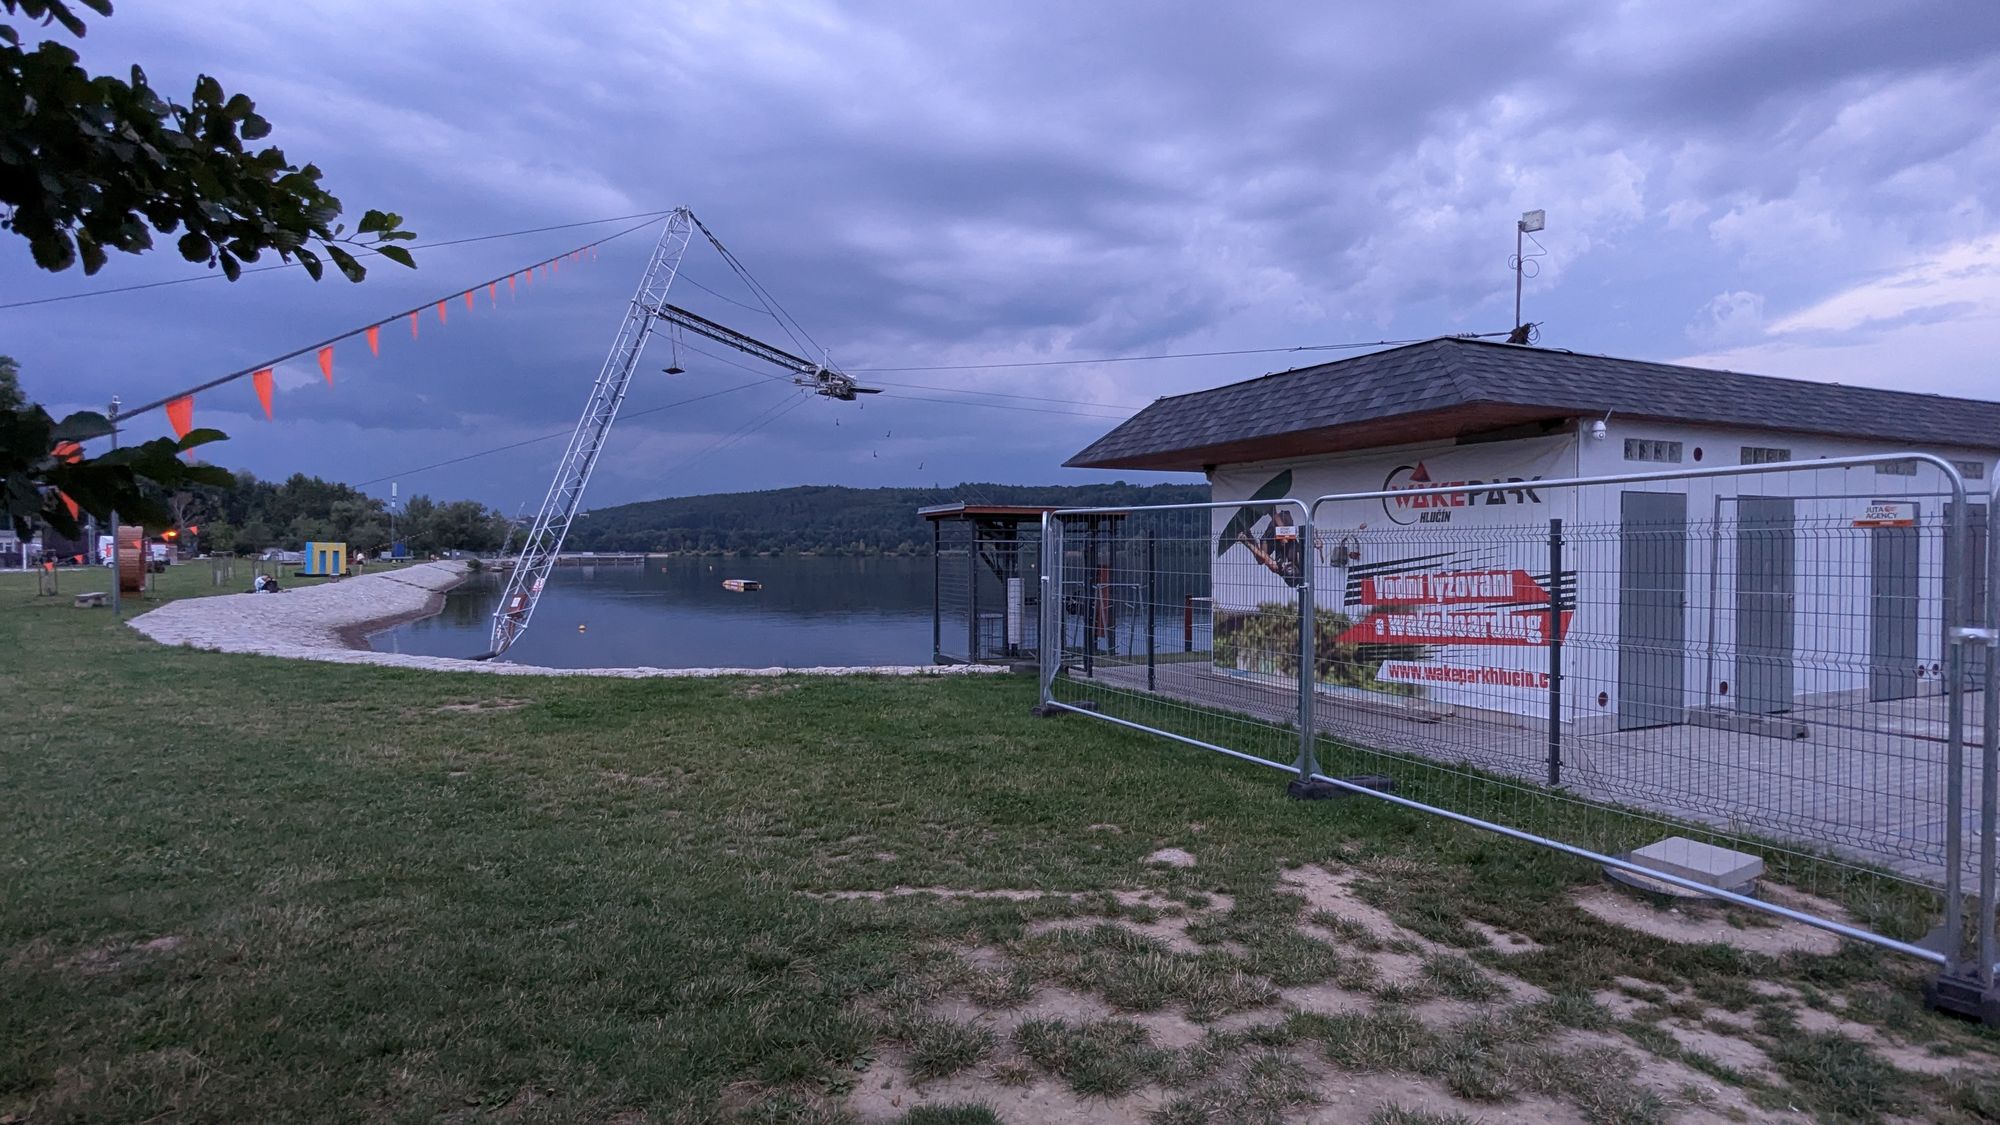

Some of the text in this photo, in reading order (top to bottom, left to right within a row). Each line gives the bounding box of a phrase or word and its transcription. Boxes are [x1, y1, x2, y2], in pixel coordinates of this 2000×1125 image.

[1392, 475, 1542, 508] WAKEPARK
[1419, 509, 1452, 523] HLUČÍN
[1373, 572, 1424, 600] Vodní
[1388, 609, 1543, 644] wakeboarding
[1389, 664, 1550, 688] www.wakeparkhlucin.c
